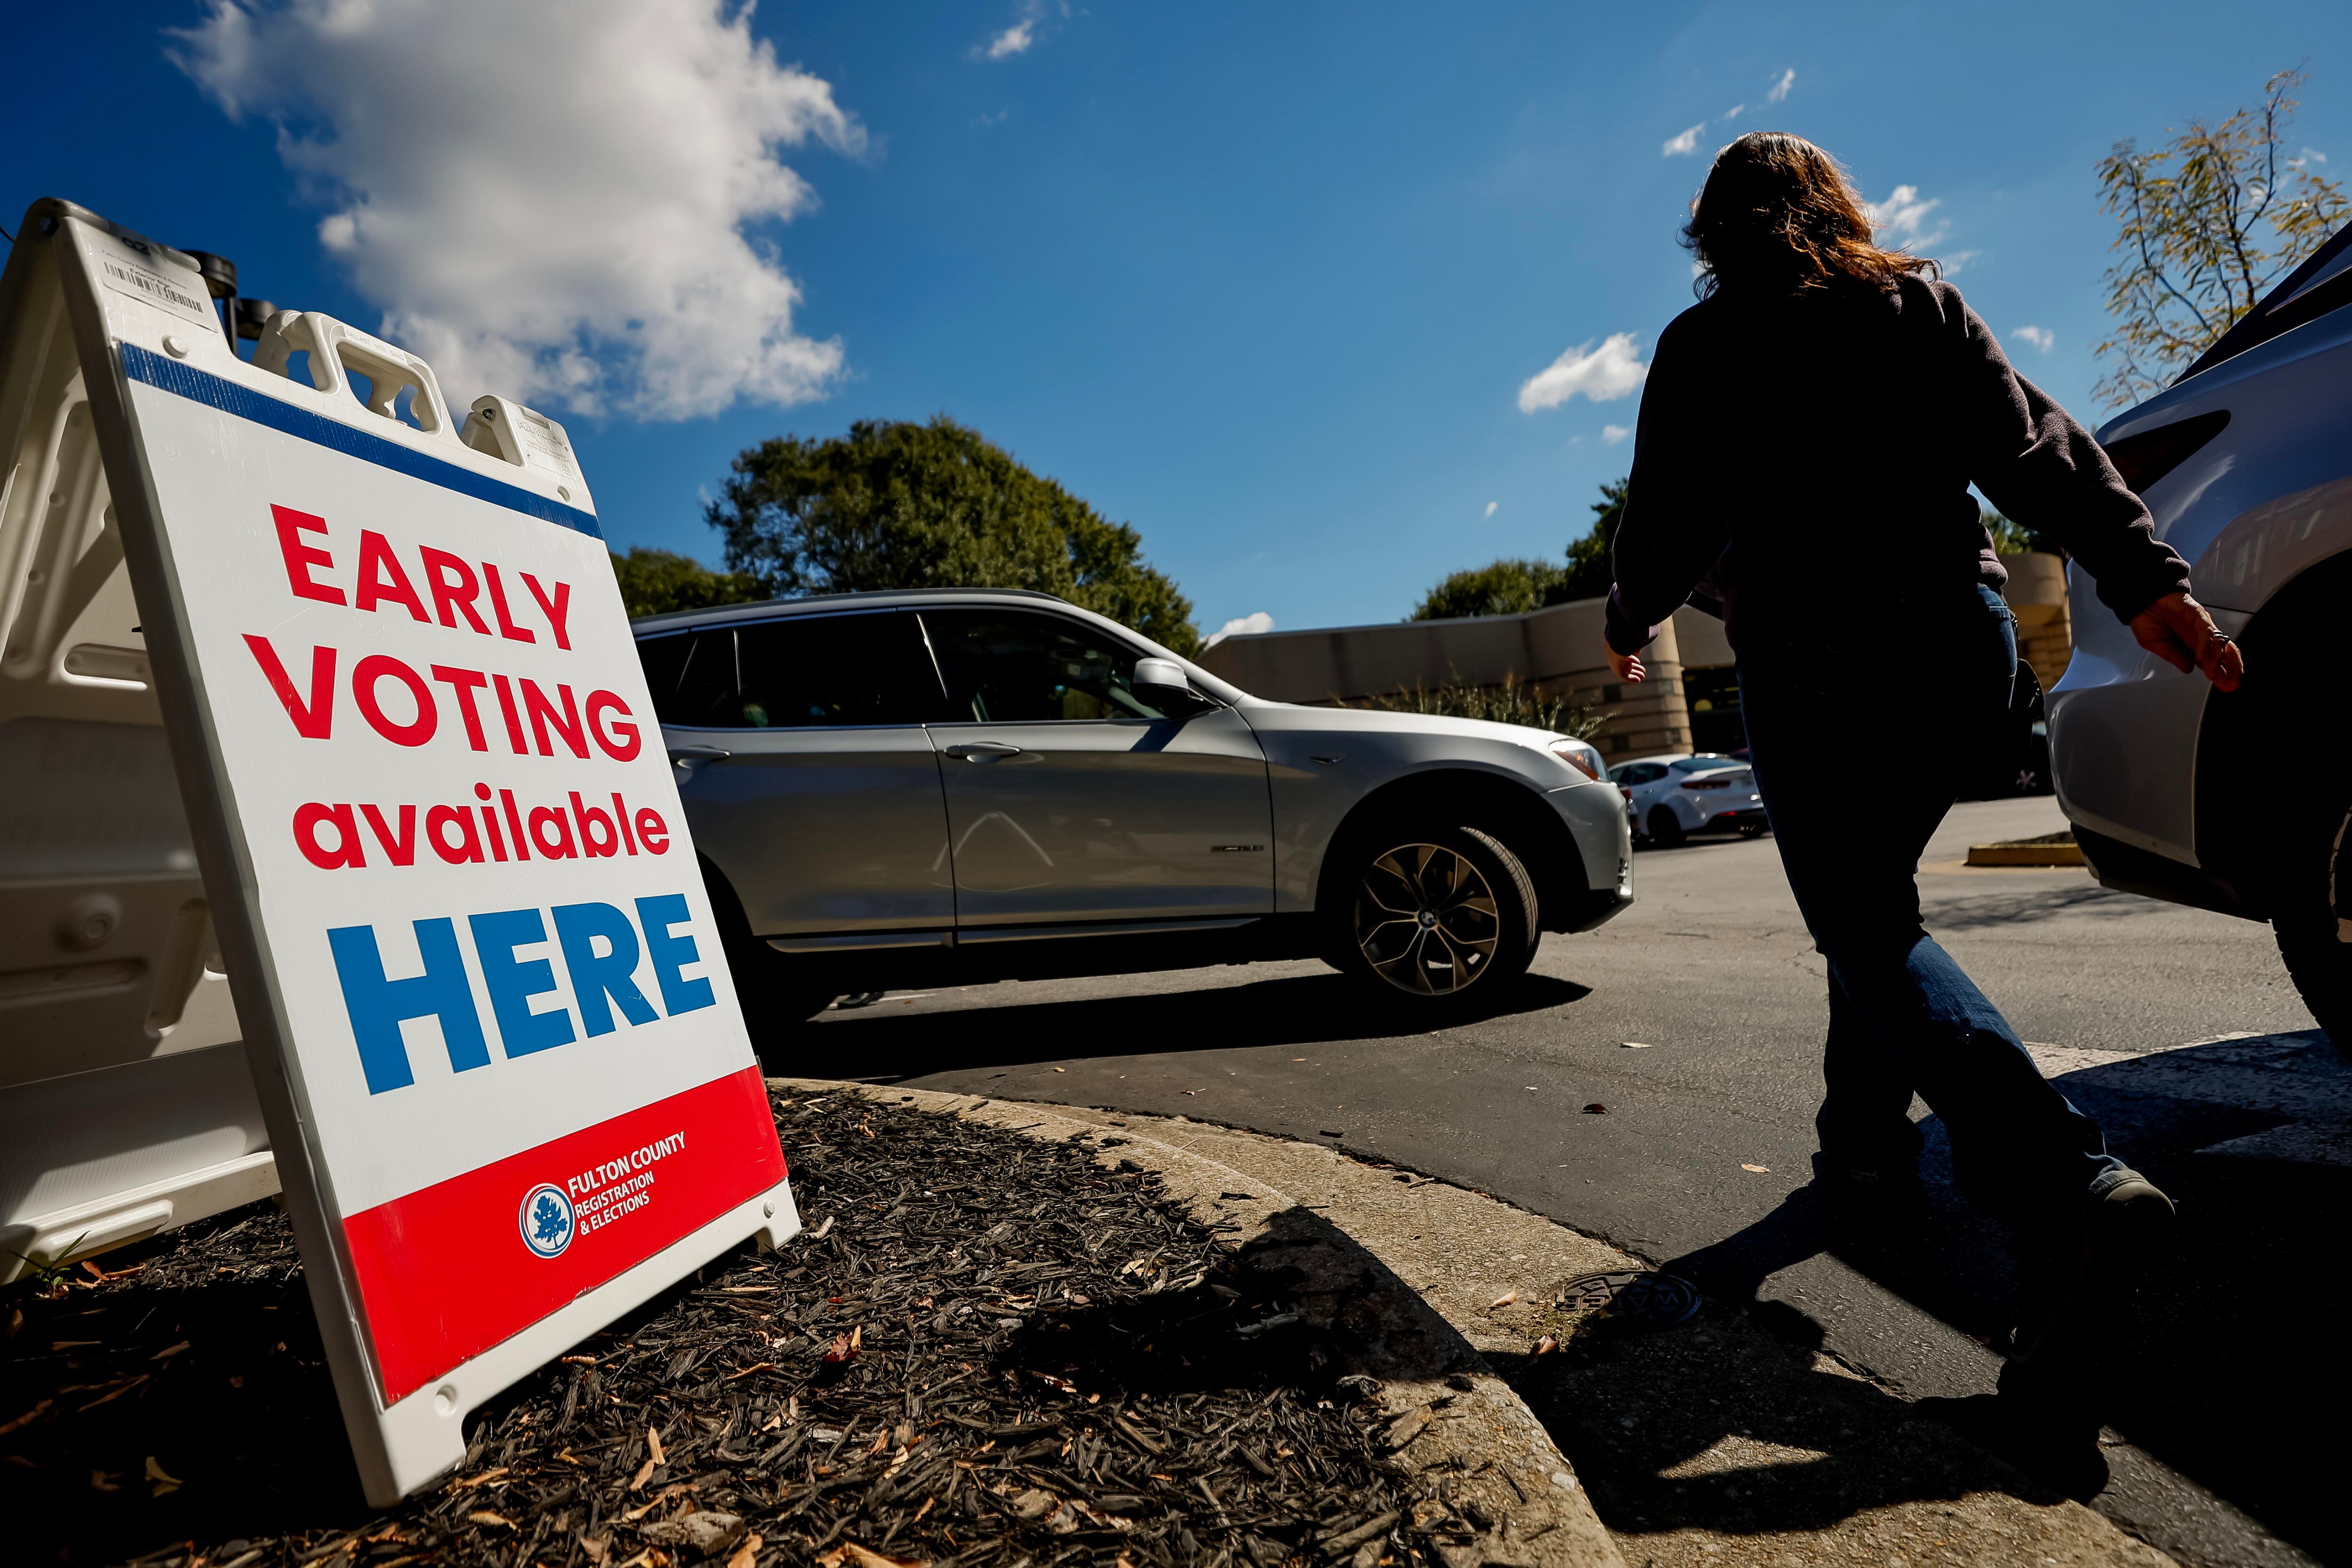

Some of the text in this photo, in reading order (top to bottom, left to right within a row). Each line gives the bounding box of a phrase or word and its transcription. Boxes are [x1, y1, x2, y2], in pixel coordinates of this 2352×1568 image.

[346, 330, 370, 345] BALLAST
[270, 503, 571, 650] EARLY
[242, 633, 641, 762] VOTING
[293, 782, 669, 870] available
[327, 893, 715, 1095] HERE
[567, 1131, 686, 1199] FULTON COUNTY
[574, 1170, 655, 1219] REGISTRATION
[580, 1190, 651, 1236] & ELECTIONS
